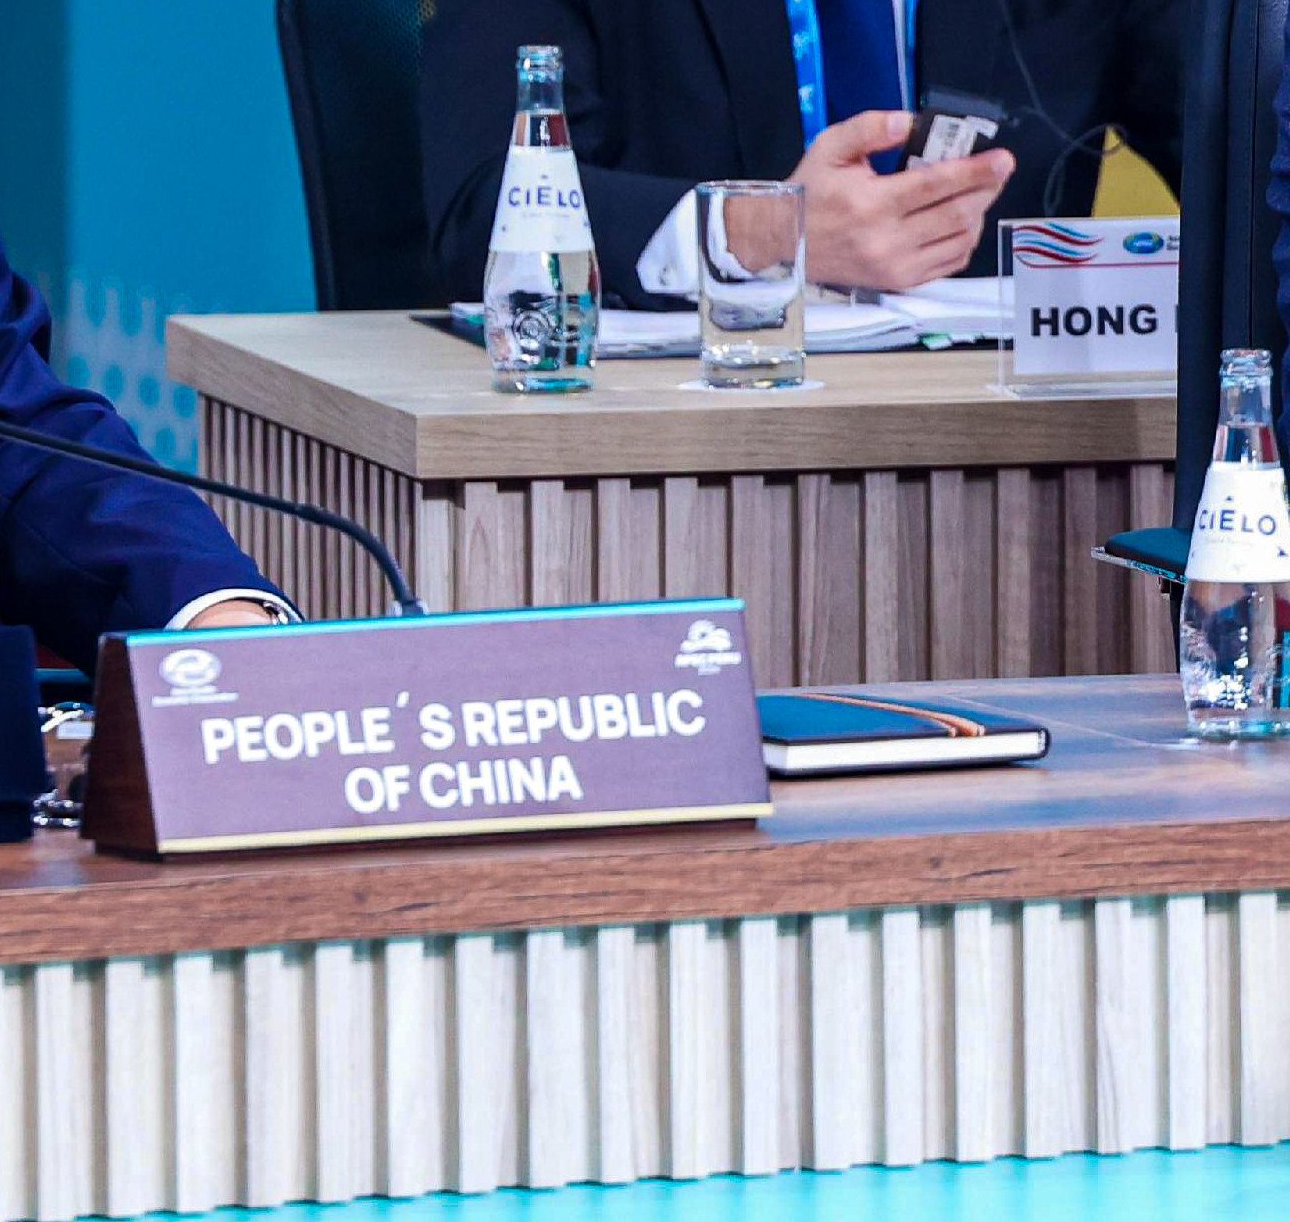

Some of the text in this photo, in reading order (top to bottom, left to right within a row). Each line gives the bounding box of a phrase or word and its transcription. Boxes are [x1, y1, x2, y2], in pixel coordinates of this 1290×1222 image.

[508, 185, 581, 209] CIELO
[1031, 304, 1157, 336] HONG
[1199, 509, 1277, 536] CIELO
[460, 689, 706, 747] REPUBLIC
[343, 755, 584, 814] OF CHINA
